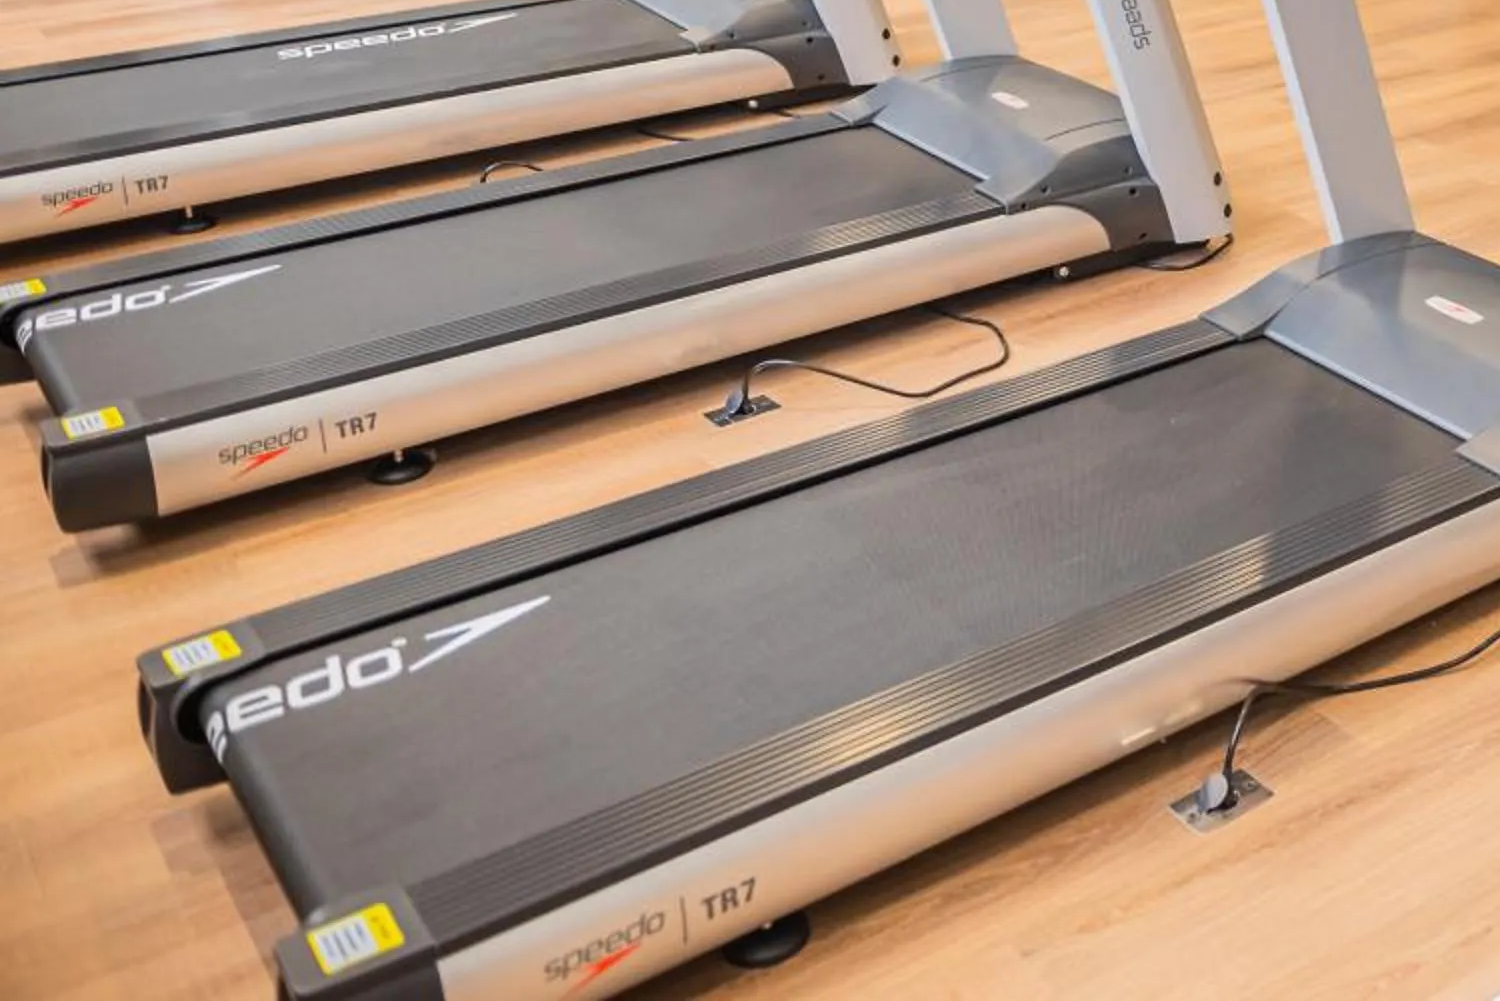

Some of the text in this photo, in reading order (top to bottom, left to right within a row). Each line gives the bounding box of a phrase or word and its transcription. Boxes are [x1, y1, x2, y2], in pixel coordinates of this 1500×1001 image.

[277, 24, 446, 60] speedo
[42, 175, 169, 208] speedo TR7
[218, 412, 377, 465] speedo TR7
[544, 876, 756, 983] speedo TR7
